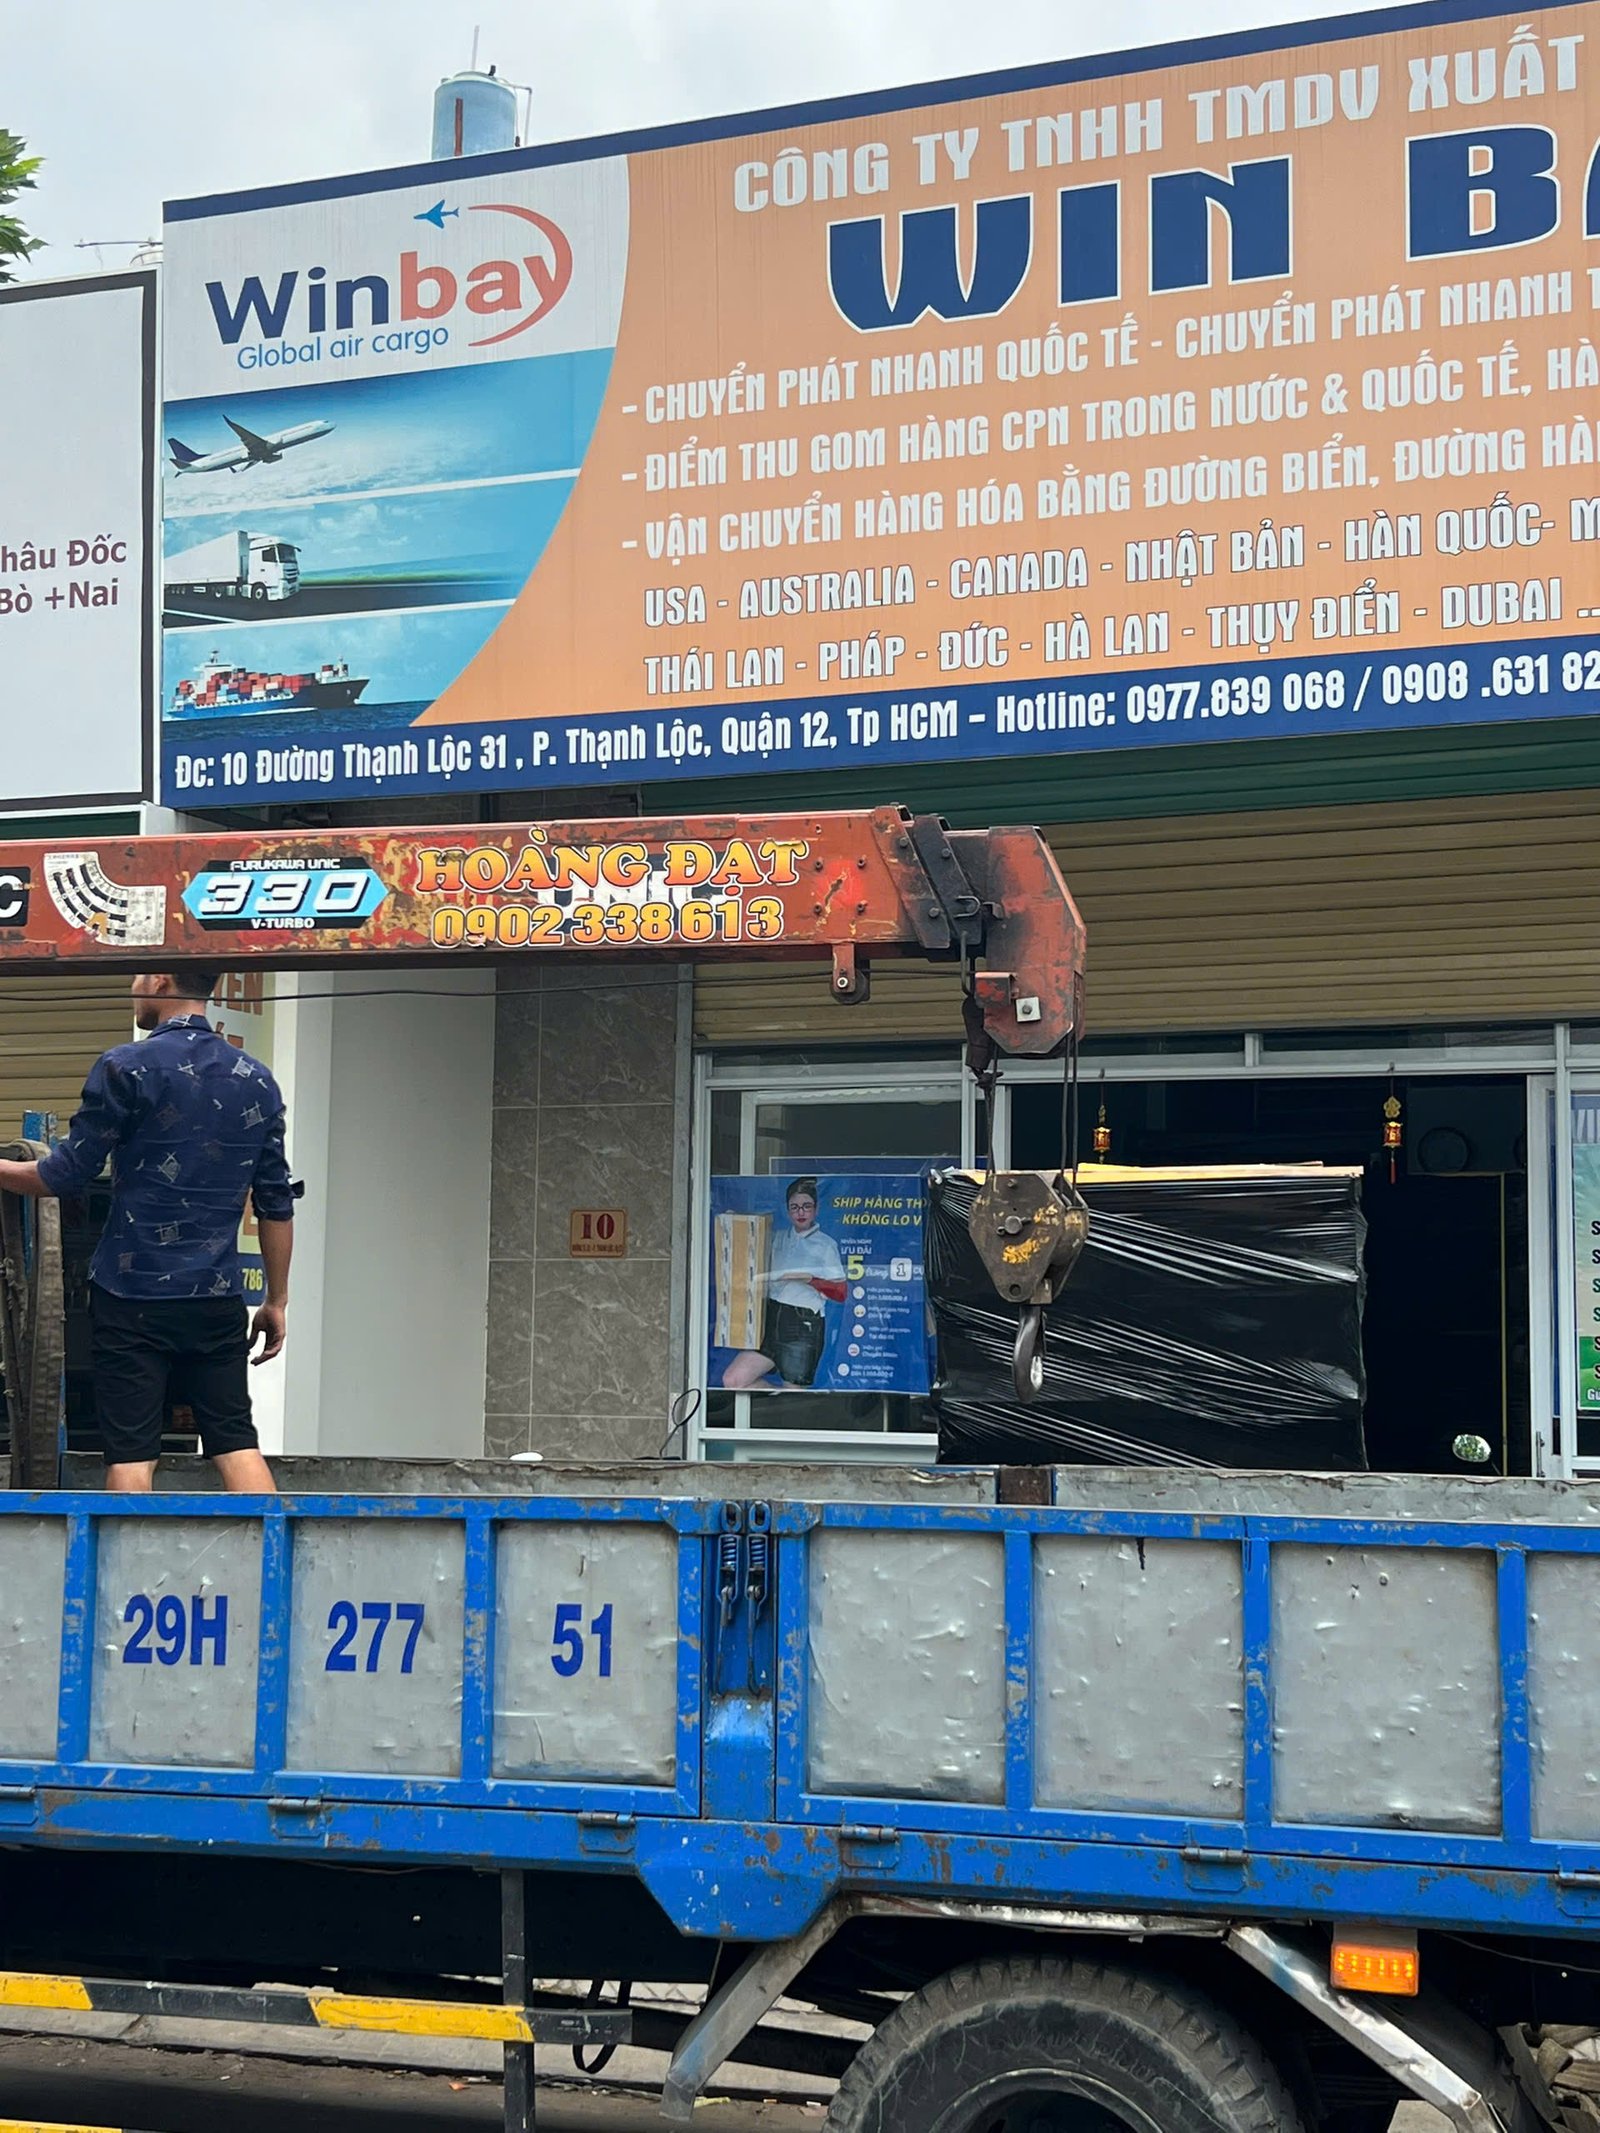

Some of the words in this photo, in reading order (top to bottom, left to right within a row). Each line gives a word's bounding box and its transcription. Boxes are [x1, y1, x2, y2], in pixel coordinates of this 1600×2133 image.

[734, 143, 890, 212] CÔNG
[912, 127, 979, 185] TY
[1001, 99, 1162, 172] TNHH
[1188, 64, 1379, 144] TMDV
[1408, 23, 1585, 112] XUẤT
[826, 154, 1293, 334] WIN
[1405, 123, 1600, 262] B
[205, 250, 572, 347] Winbay
[237, 335, 321, 370] Global
[329, 333, 364, 359] air
[371, 326, 449, 355] cargo
[645, 361, 765, 424] CHUYỂN
[778, 356, 859, 408] PHÁT
[871, 345, 983, 397] NHANH
[996, 321, 1089, 382] QUỐC
[1100, 312, 1139, 368] TẾ
[1175, 290, 1316, 359] CHUYỂN
[1331, 284, 1425, 340] PHÁT
[1440, 271, 1572, 327] NHANH
[644, 435, 727, 492] ĐIỂM
[738, 437, 798, 481] THU
[810, 427, 885, 474] GOM
[899, 414, 989, 464] HÀNG
[1002, 405, 1069, 452] CPN
[1081, 391, 1196, 442] TRONG
[1210, 373, 1308, 428] NƯỚC
[1321, 372, 1349, 415] &
[1362, 348, 1464, 412] QUỐC
[645, 512, 707, 566] VẬN
[719, 490, 842, 552] CHUYỂN
[854, 490, 944, 539] HÀNG
[956, 478, 1024, 528] HÓA
[1037, 463, 1131, 519] BẰNG
[1143, 455, 1268, 508] ĐƯỜNG
[1392, 427, 1526, 483] ĐƯỜNG
[1542, 415, 1600, 468] HÀ
[66, 533, 127, 566] Đốc
[644, 584, 707, 628] USA
[739, 564, 915, 620] AUSTRALIA
[949, 546, 1088, 600] CANADA
[1125, 528, 1218, 587] NHẬT
[1230, 518, 1305, 573] BẢN
[1344, 509, 1422, 563] HÀN
[643, 646, 714, 695] THÁI
[725, 646, 785, 689] LAN
[818, 630, 906, 681] PHÁP
[938, 621, 1009, 671] ĐỨC
[1044, 612, 1091, 663] HÀ
[1104, 611, 1169, 657] LAN
[1206, 599, 1300, 654] THỤY
[1310, 577, 1400, 640] ĐIỂN
[1441, 577, 1562, 629] DUBAI
[175, 754, 214, 789] Đc:
[221, 751, 248, 787] 10
[255, 744, 334, 784] Đường
[342, 739, 419, 784] Thạnh
[427, 734, 472, 780] Lộc
[479, 733, 507, 770] 31
[532, 730, 557, 767] P.
[565, 724, 646, 770] Thạnh
[656, 718, 712, 765] Lộc,
[721, 711, 792, 759] Quận
[800, 710, 838, 749] 12,
[847, 707, 880, 747] Tp
[890, 699, 959, 742] HCM
[996, 690, 1116, 734] Hotline:
[1126, 675, 1271, 724] 0977.839
[1282, 669, 1345, 712] 068
[1381, 659, 1469, 705] 0908
[198, 872, 370, 914] 330
[230, 860, 305, 871] FURUKAWA
[417, 827, 650, 892] HOÀNG
[664, 839, 808, 897] ĐẠT
[251, 917, 315, 929] V-TURBO
[581, 1213, 615, 1240] 10
[833, 1197, 861, 1208] SHIP
[864, 1195, 902, 1209] HÀNG
[842, 1211, 890, 1226] KHÔNG
[893, 1214, 910, 1226] LO
[242, 1268, 264, 1291] 786
[847, 1255, 864, 1280] 5
[896, 1262, 906, 1277] 1
[122, 1593, 228, 1666] 29H
[325, 1600, 425, 1674] 277
[550, 1603, 613, 1677] 51
